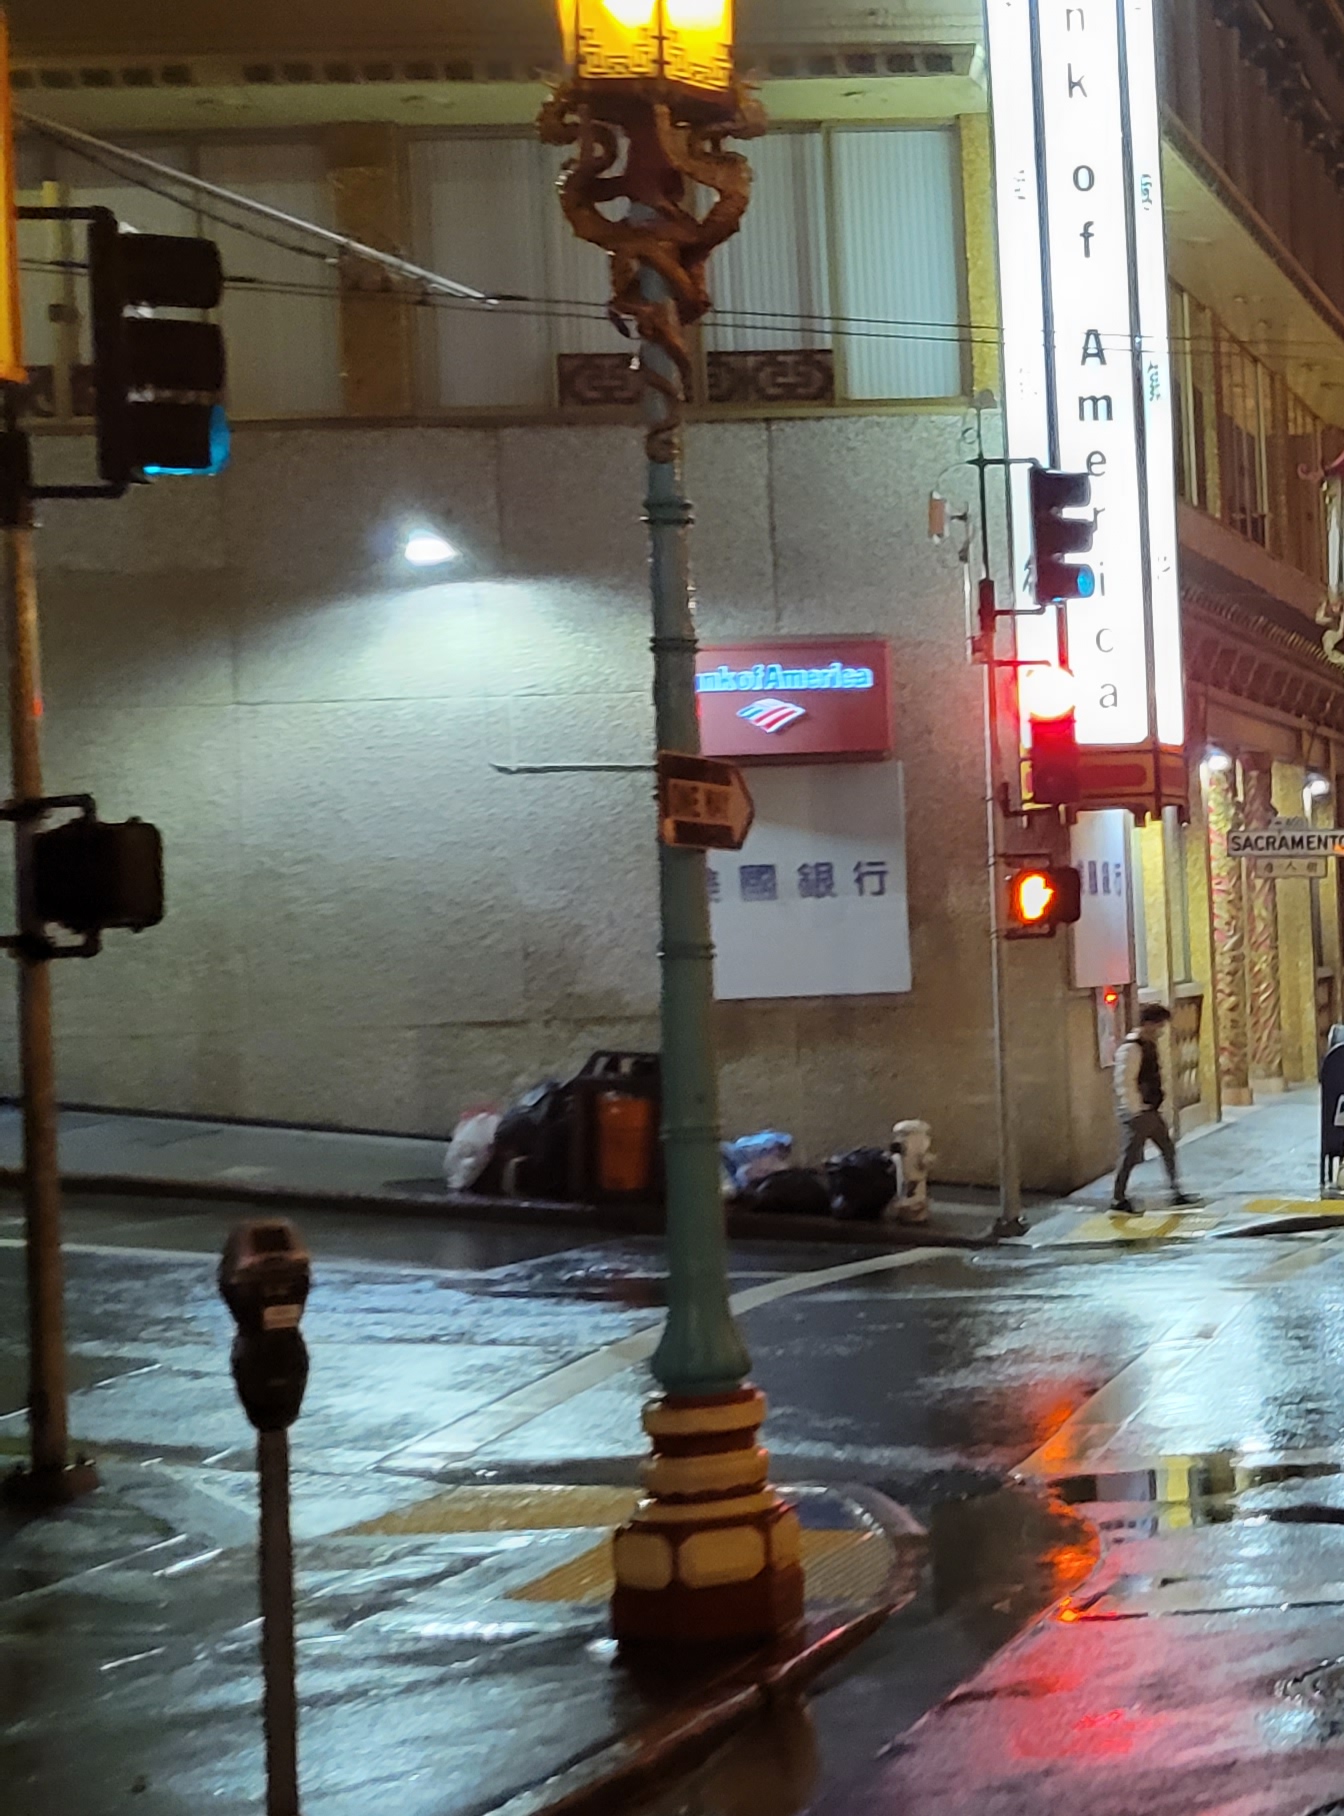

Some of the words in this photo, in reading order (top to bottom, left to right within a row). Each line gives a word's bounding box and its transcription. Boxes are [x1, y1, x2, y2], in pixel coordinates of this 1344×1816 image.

[1072, 165, 1096, 258] of
[1079, 329, 1119, 708] America
[737, 663, 766, 691] of
[765, 660, 875, 690] America
